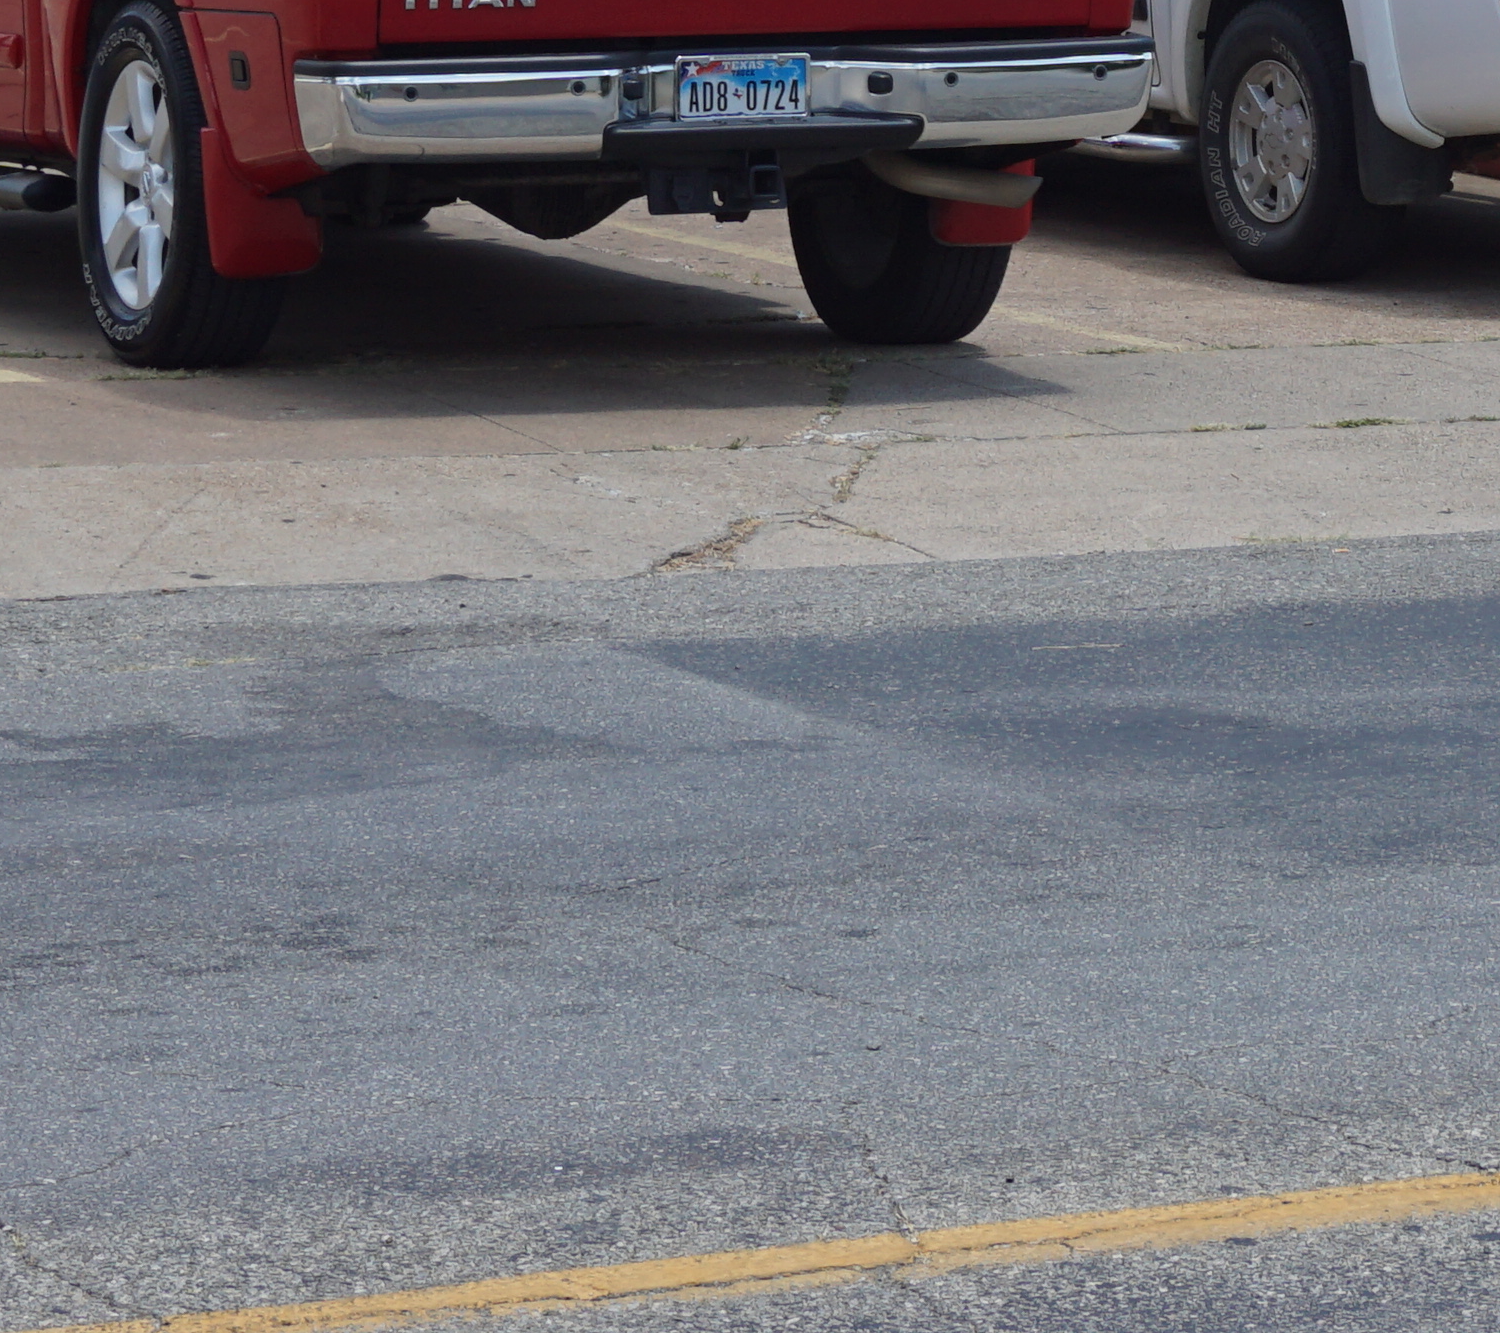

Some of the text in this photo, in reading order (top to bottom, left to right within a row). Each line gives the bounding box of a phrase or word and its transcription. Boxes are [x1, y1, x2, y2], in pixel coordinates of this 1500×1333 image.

[722, 61, 765, 70] TEXAS
[689, 79, 800, 112] AD8 0724
